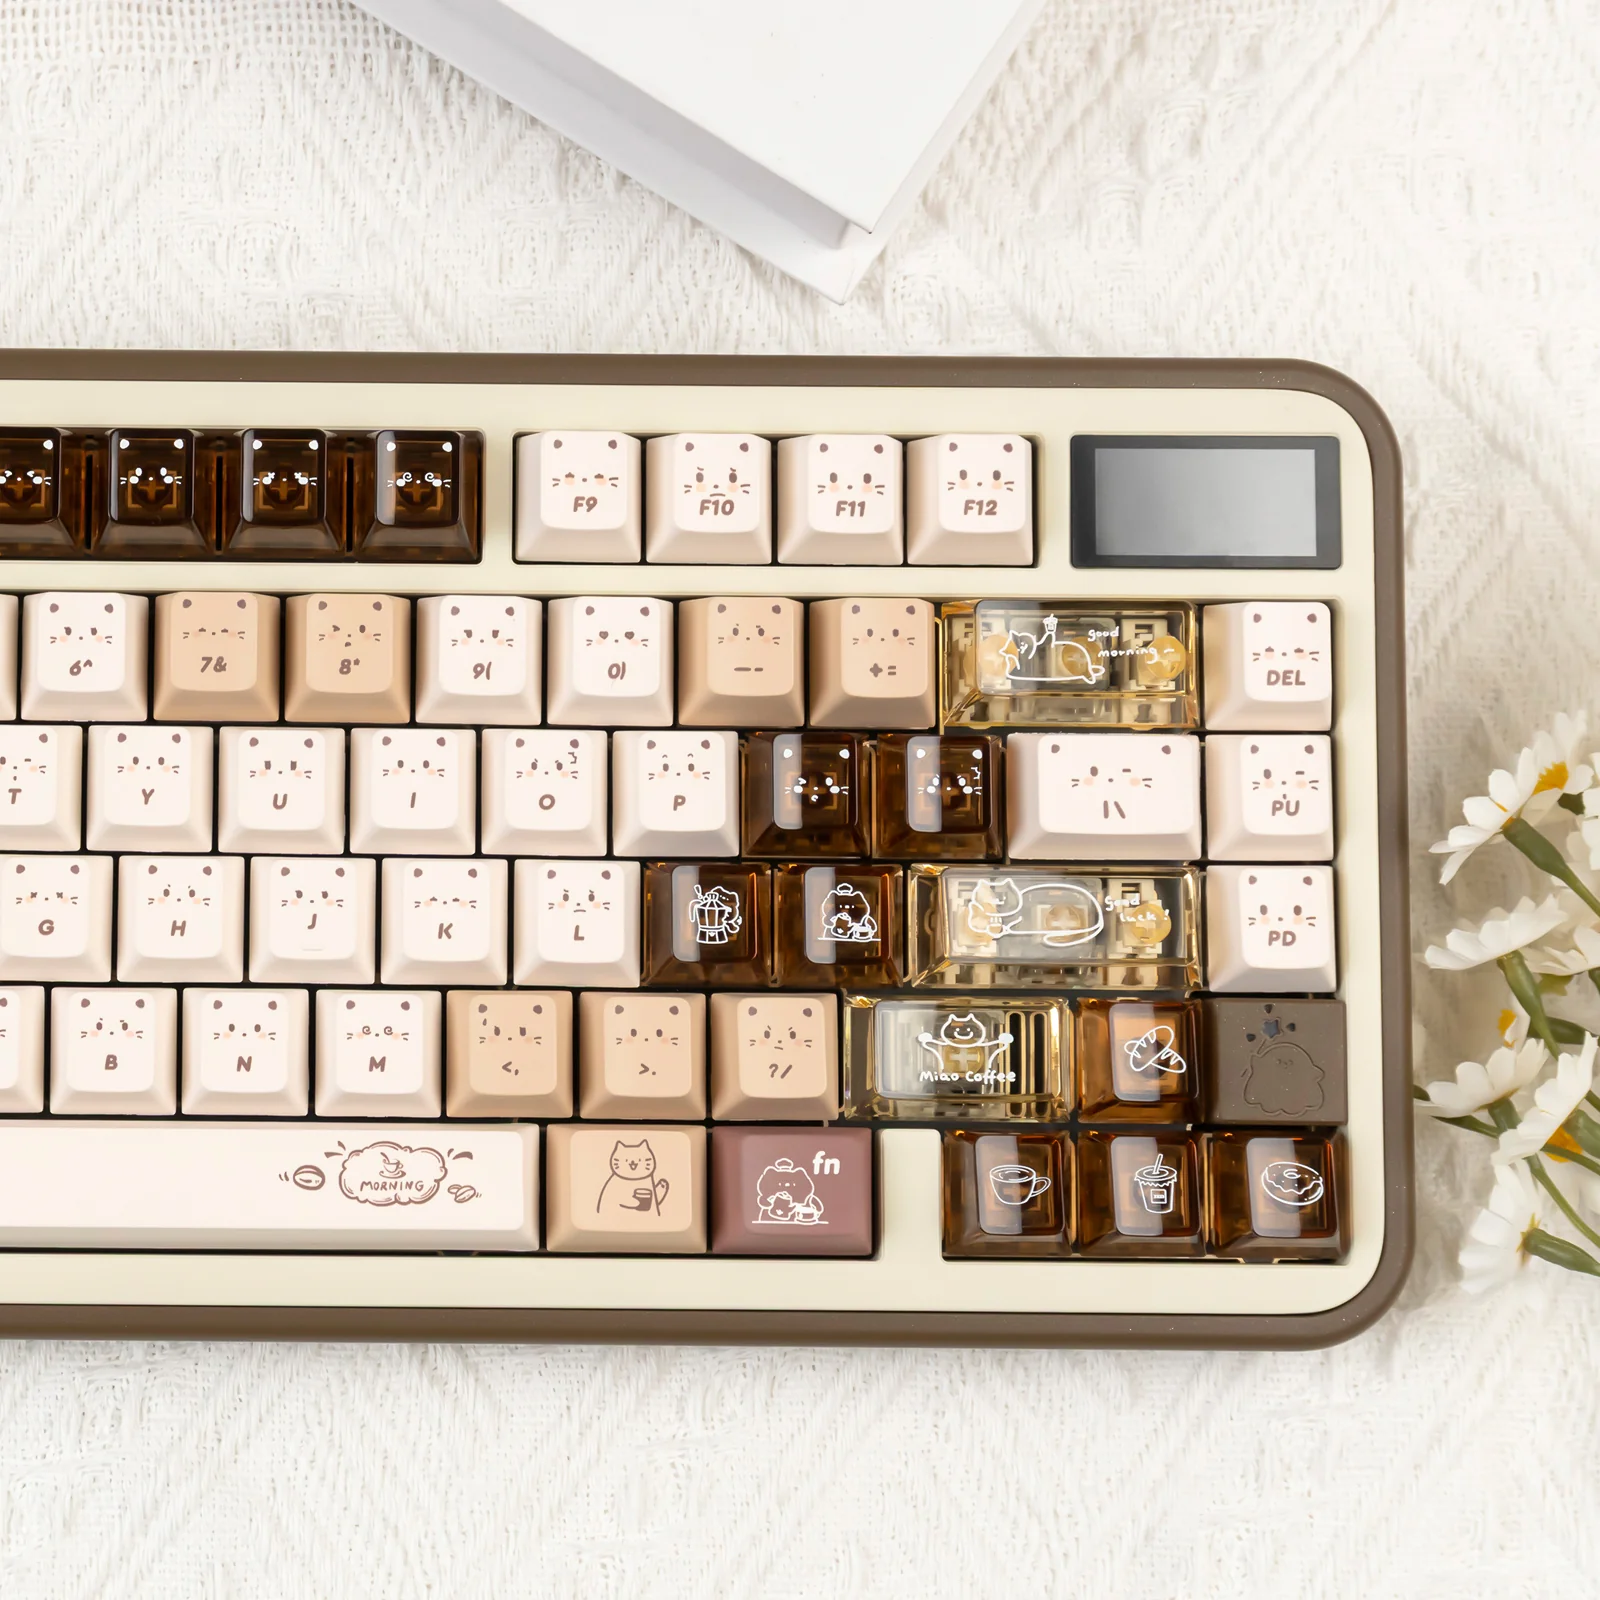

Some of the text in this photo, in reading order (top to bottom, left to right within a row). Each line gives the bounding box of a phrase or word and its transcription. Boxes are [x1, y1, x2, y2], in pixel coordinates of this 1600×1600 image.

[573, 496, 598, 513] F9
[699, 499, 735, 516] F10
[835, 500, 866, 517] F11
[963, 499, 998, 516] F12
[1087, 625, 1120, 642] good
[1098, 646, 1159, 665] morning
[200, 656, 227, 673] 7&
[1266, 669, 1306, 686] DEL
[8, 788, 22, 805] T
[141, 788, 155, 805] Y
[272, 793, 288, 810] U
[410, 791, 417, 809] I
[538, 793, 556, 811] O
[672, 794, 687, 812] P
[1271, 800, 1300, 817] PU
[38, 919, 55, 936] G
[170, 919, 187, 937] H
[307, 913, 318, 930] J
[437, 922, 454, 940] K
[573, 924, 585, 941] L
[1268, 930, 1297, 947] PD
[104, 1054, 118, 1071] B
[236, 1055, 253, 1073] N
[368, 1056, 387, 1073] M
[919, 1069, 1016, 1085] Miao Coffee
[812, 1150, 841, 1176] fn
[359, 1180, 425, 1194] MORNING
